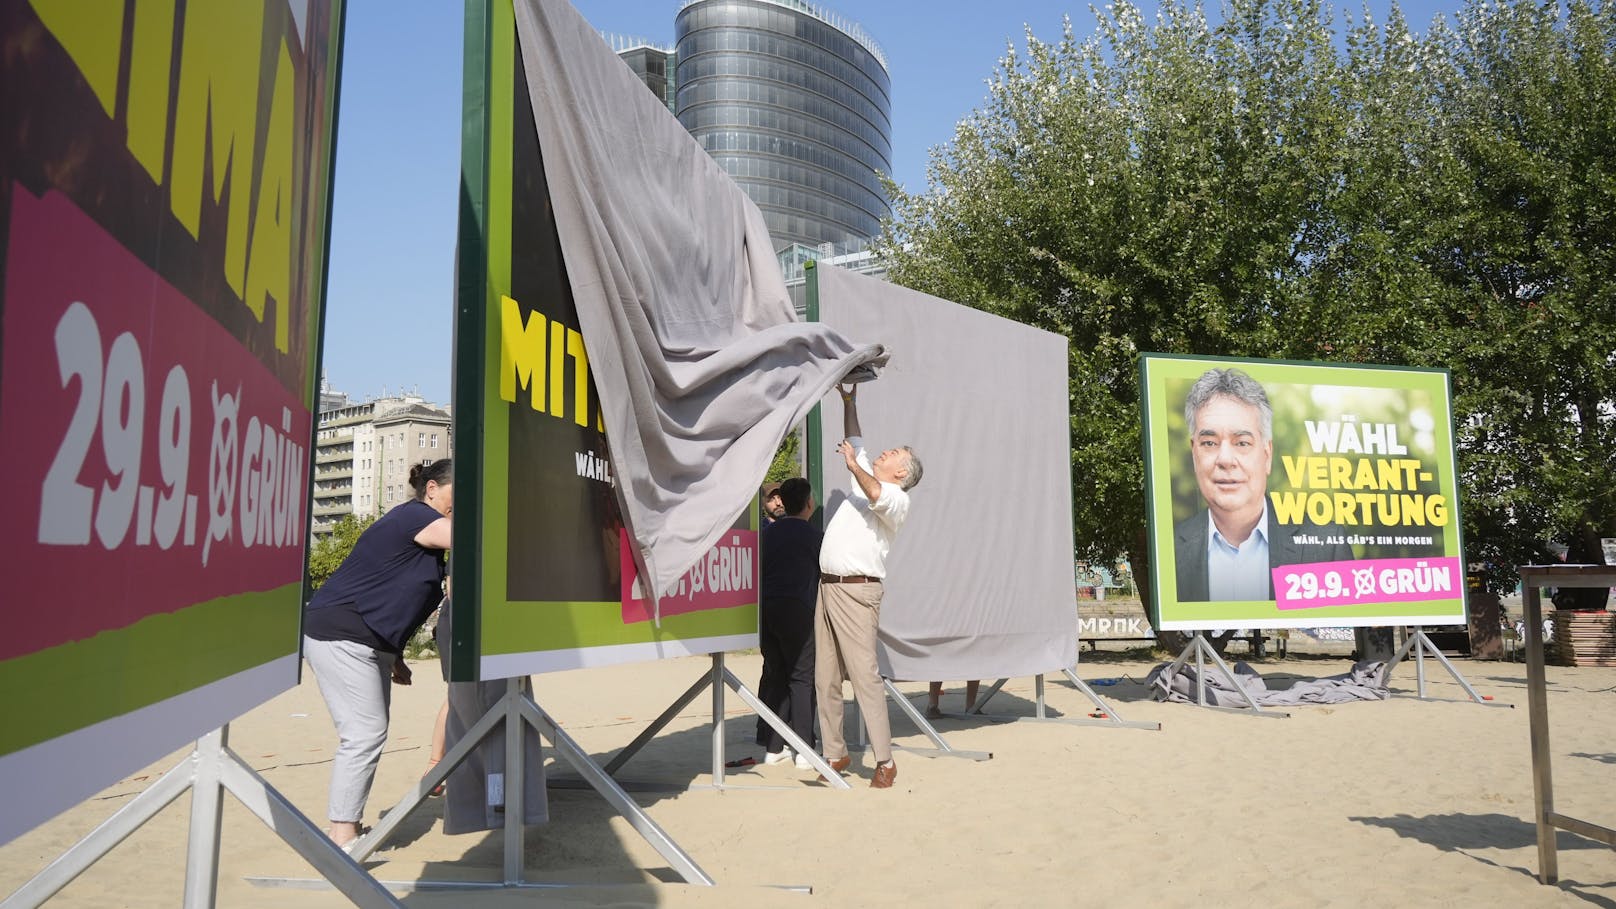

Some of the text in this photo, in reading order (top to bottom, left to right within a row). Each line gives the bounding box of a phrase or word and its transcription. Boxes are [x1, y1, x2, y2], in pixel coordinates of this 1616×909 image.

[28, 0, 295, 354] MA
[500, 295, 606, 433] MIT
[37, 301, 304, 550] 29.9. GRÜN
[1304, 414, 1407, 456] WÄHL
[575, 450, 616, 488] WÄHL,
[1281, 455, 1433, 492] VERANT-
[1270, 491, 1448, 527] WORTUNG
[1292, 534, 1433, 546] WÄHL, ALS GÄB'S EIN MORGEN
[707, 535, 753, 593] GRÜN
[1285, 561, 1451, 600] 29.9. GRÜN
